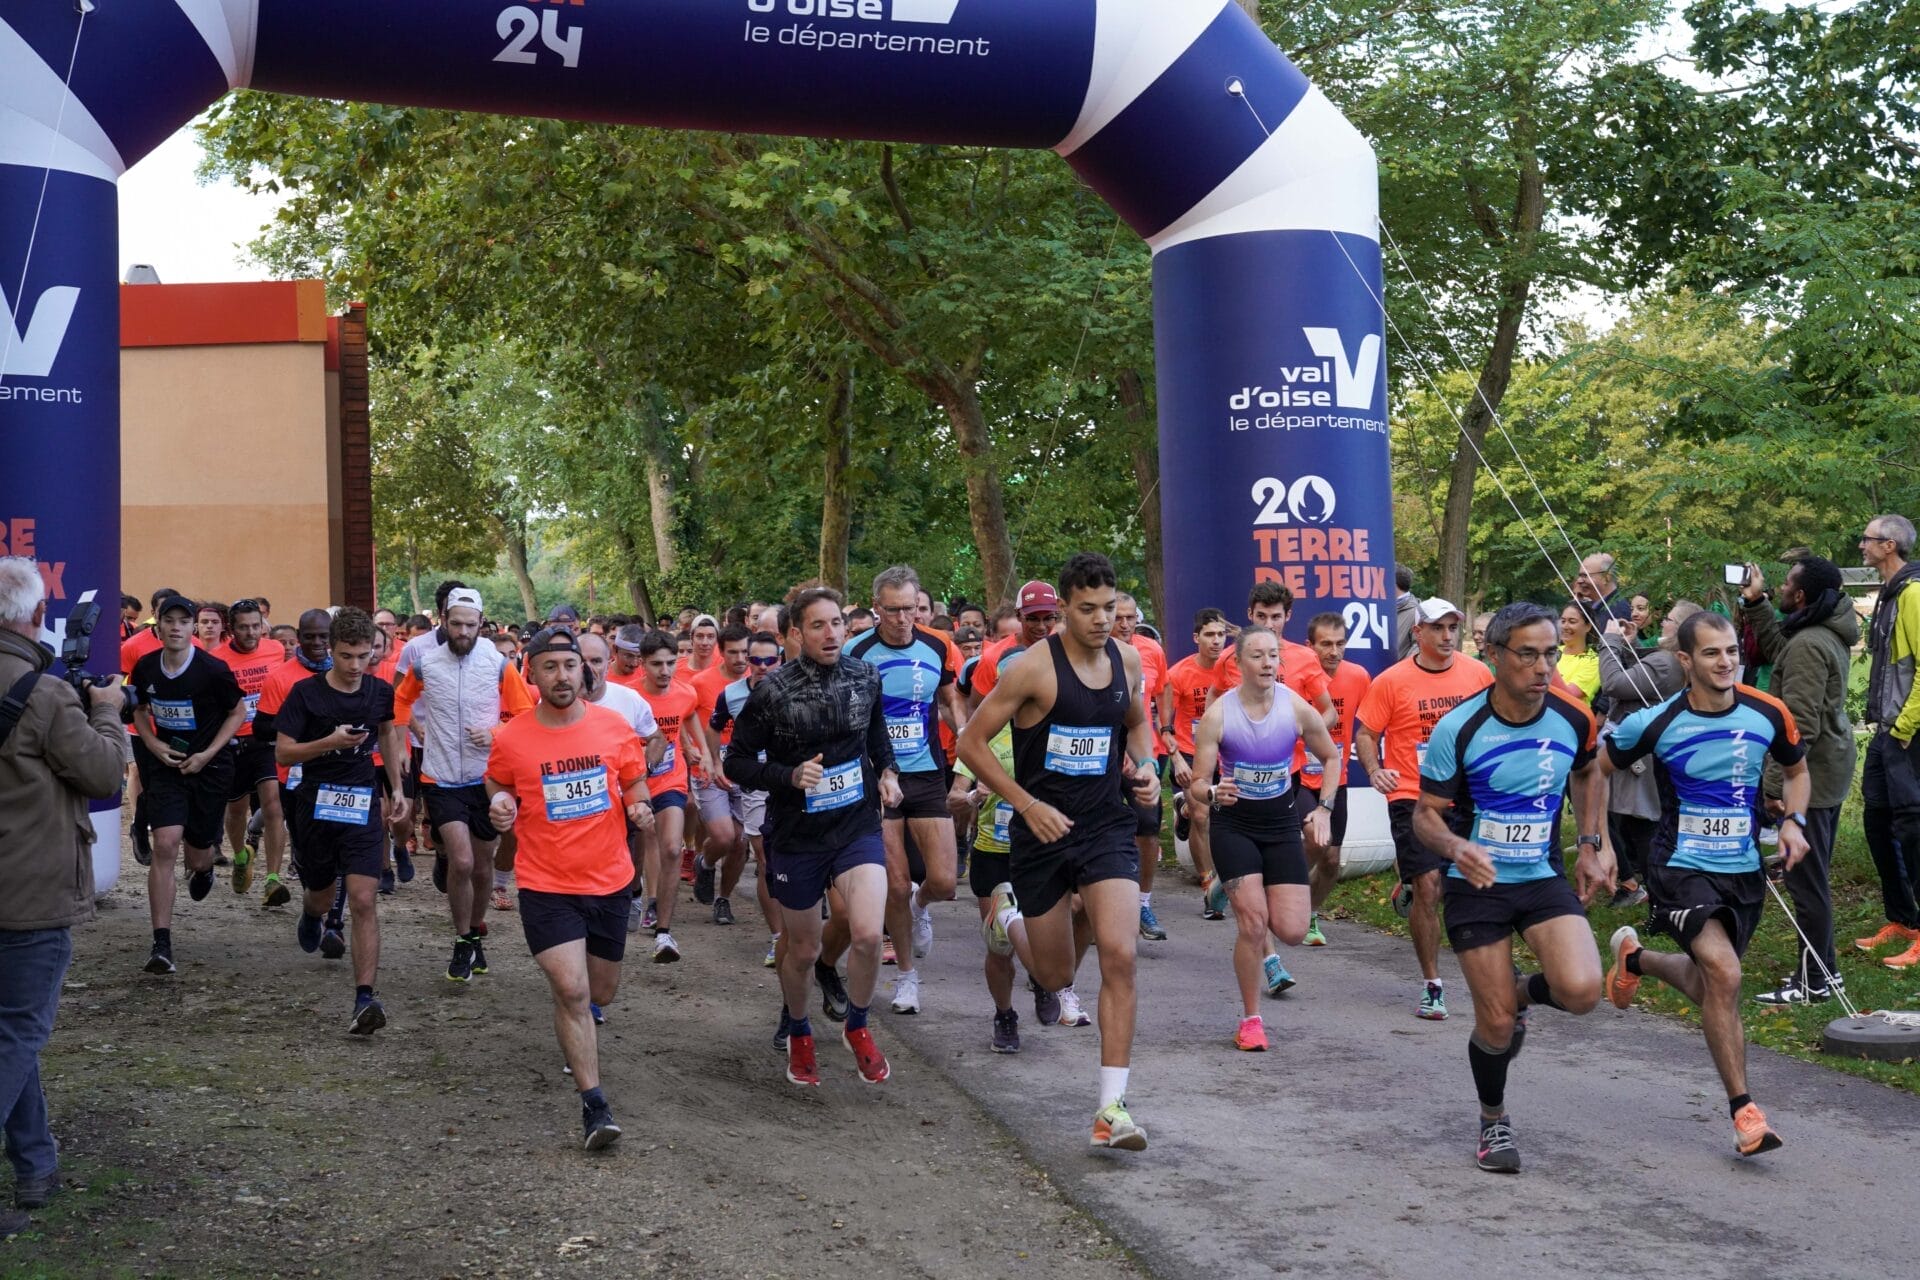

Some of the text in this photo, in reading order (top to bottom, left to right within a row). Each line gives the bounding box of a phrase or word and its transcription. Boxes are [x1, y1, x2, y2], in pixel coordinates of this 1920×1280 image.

[492, 5, 583, 68] 24
[744, 20, 990, 56] le département
[1280, 361, 1330, 383] val
[1229, 385, 1331, 410] d'oise
[1230, 412, 1386, 434] le département
[1253, 528, 1369, 563] TERRE
[1314, 565, 1387, 600] JEUX
[1342, 601, 1389, 650] 24
[162, 707, 179, 718] 384
[1418, 695, 1464, 711] JE DONN
[1420, 712, 1437, 721] MON
[888, 724, 909, 739] 326
[1070, 738, 1094, 756] 500
[540, 754, 601, 776] JE DONNE
[829, 774, 845, 792] 53
[1253, 771, 1273, 784] 377
[565, 780, 592, 800] 345
[333, 792, 356, 808] 250
[1505, 824, 1531, 843] 122
[1702, 818, 1730, 836] 348
